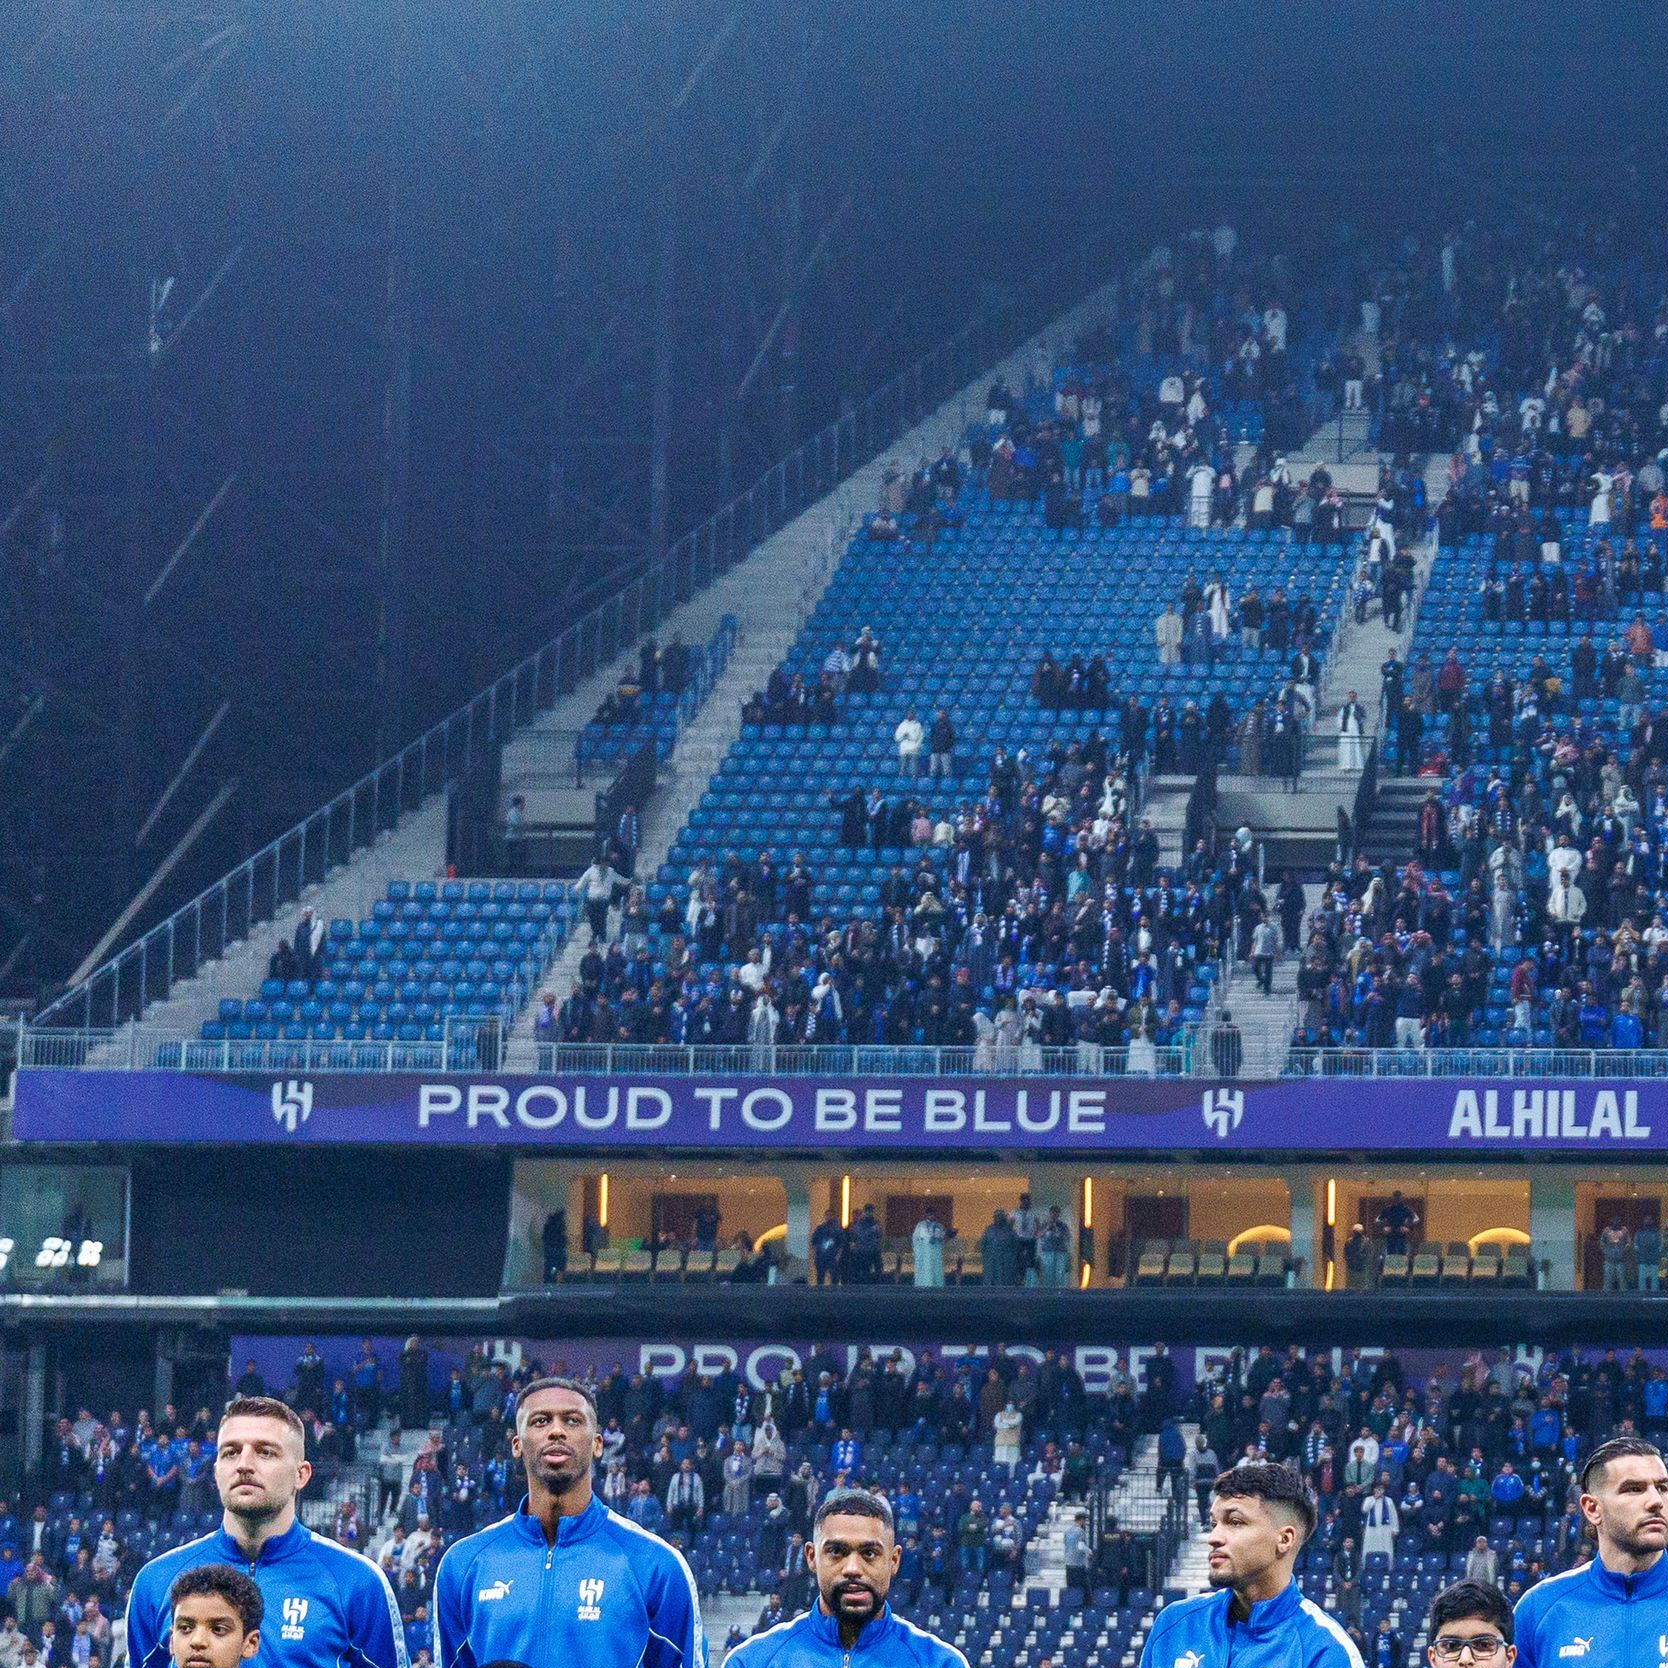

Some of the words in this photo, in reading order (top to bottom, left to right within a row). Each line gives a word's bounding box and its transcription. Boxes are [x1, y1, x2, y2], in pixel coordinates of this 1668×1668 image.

[417, 1084, 673, 1132] PROUD
[694, 1086, 794, 1132] TO
[815, 1088, 904, 1133] BE
[923, 1088, 1108, 1134] BLUE
[1447, 1088, 1652, 1140] ALHILAL
